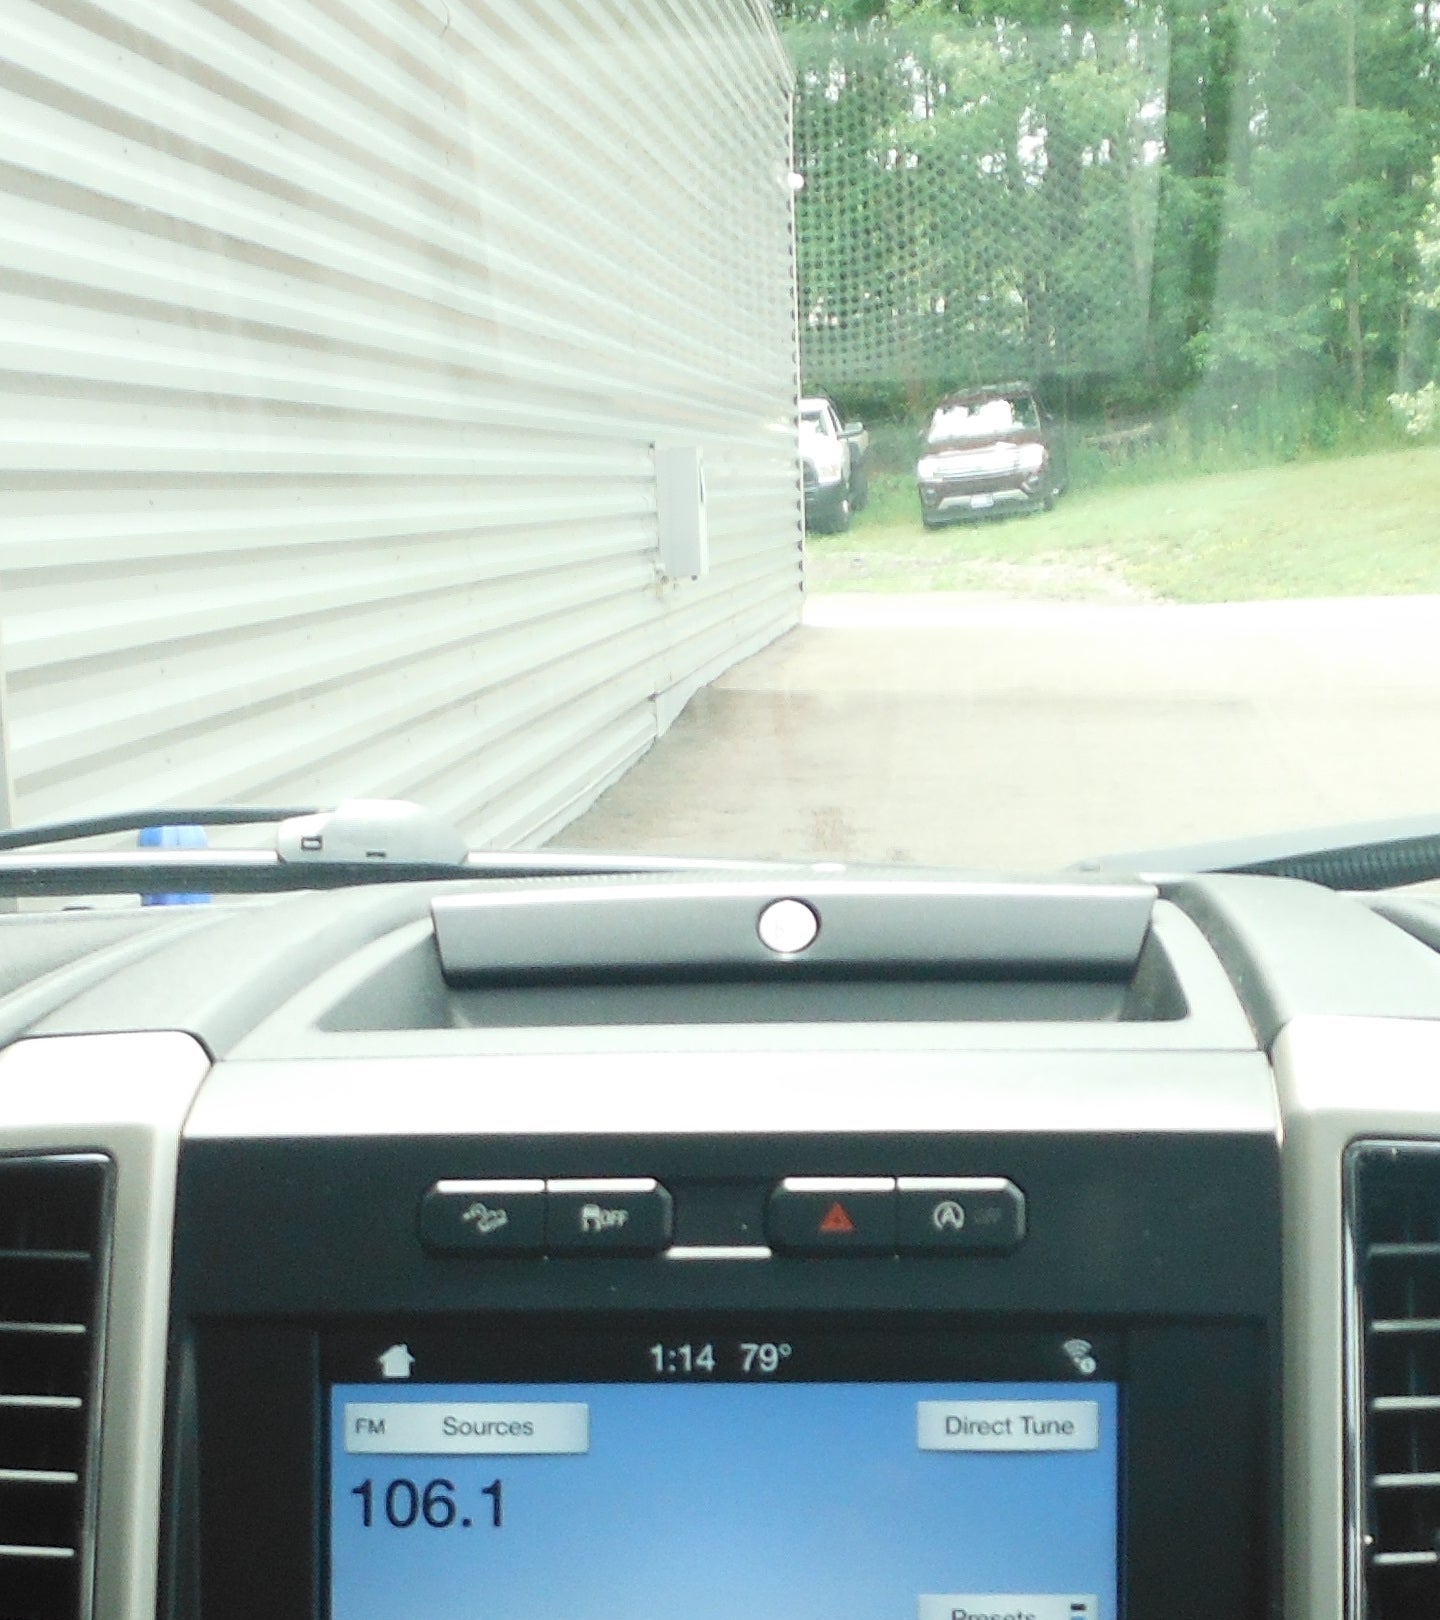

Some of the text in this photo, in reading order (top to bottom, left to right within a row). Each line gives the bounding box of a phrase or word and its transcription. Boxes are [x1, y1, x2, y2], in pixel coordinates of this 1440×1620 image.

[651, 1343, 792, 1372] 1:14 79°
[355, 1416, 534, 1437] FM Sources
[945, 1415, 1074, 1436] Direct Tune
[351, 1479, 506, 1528] 106.1
